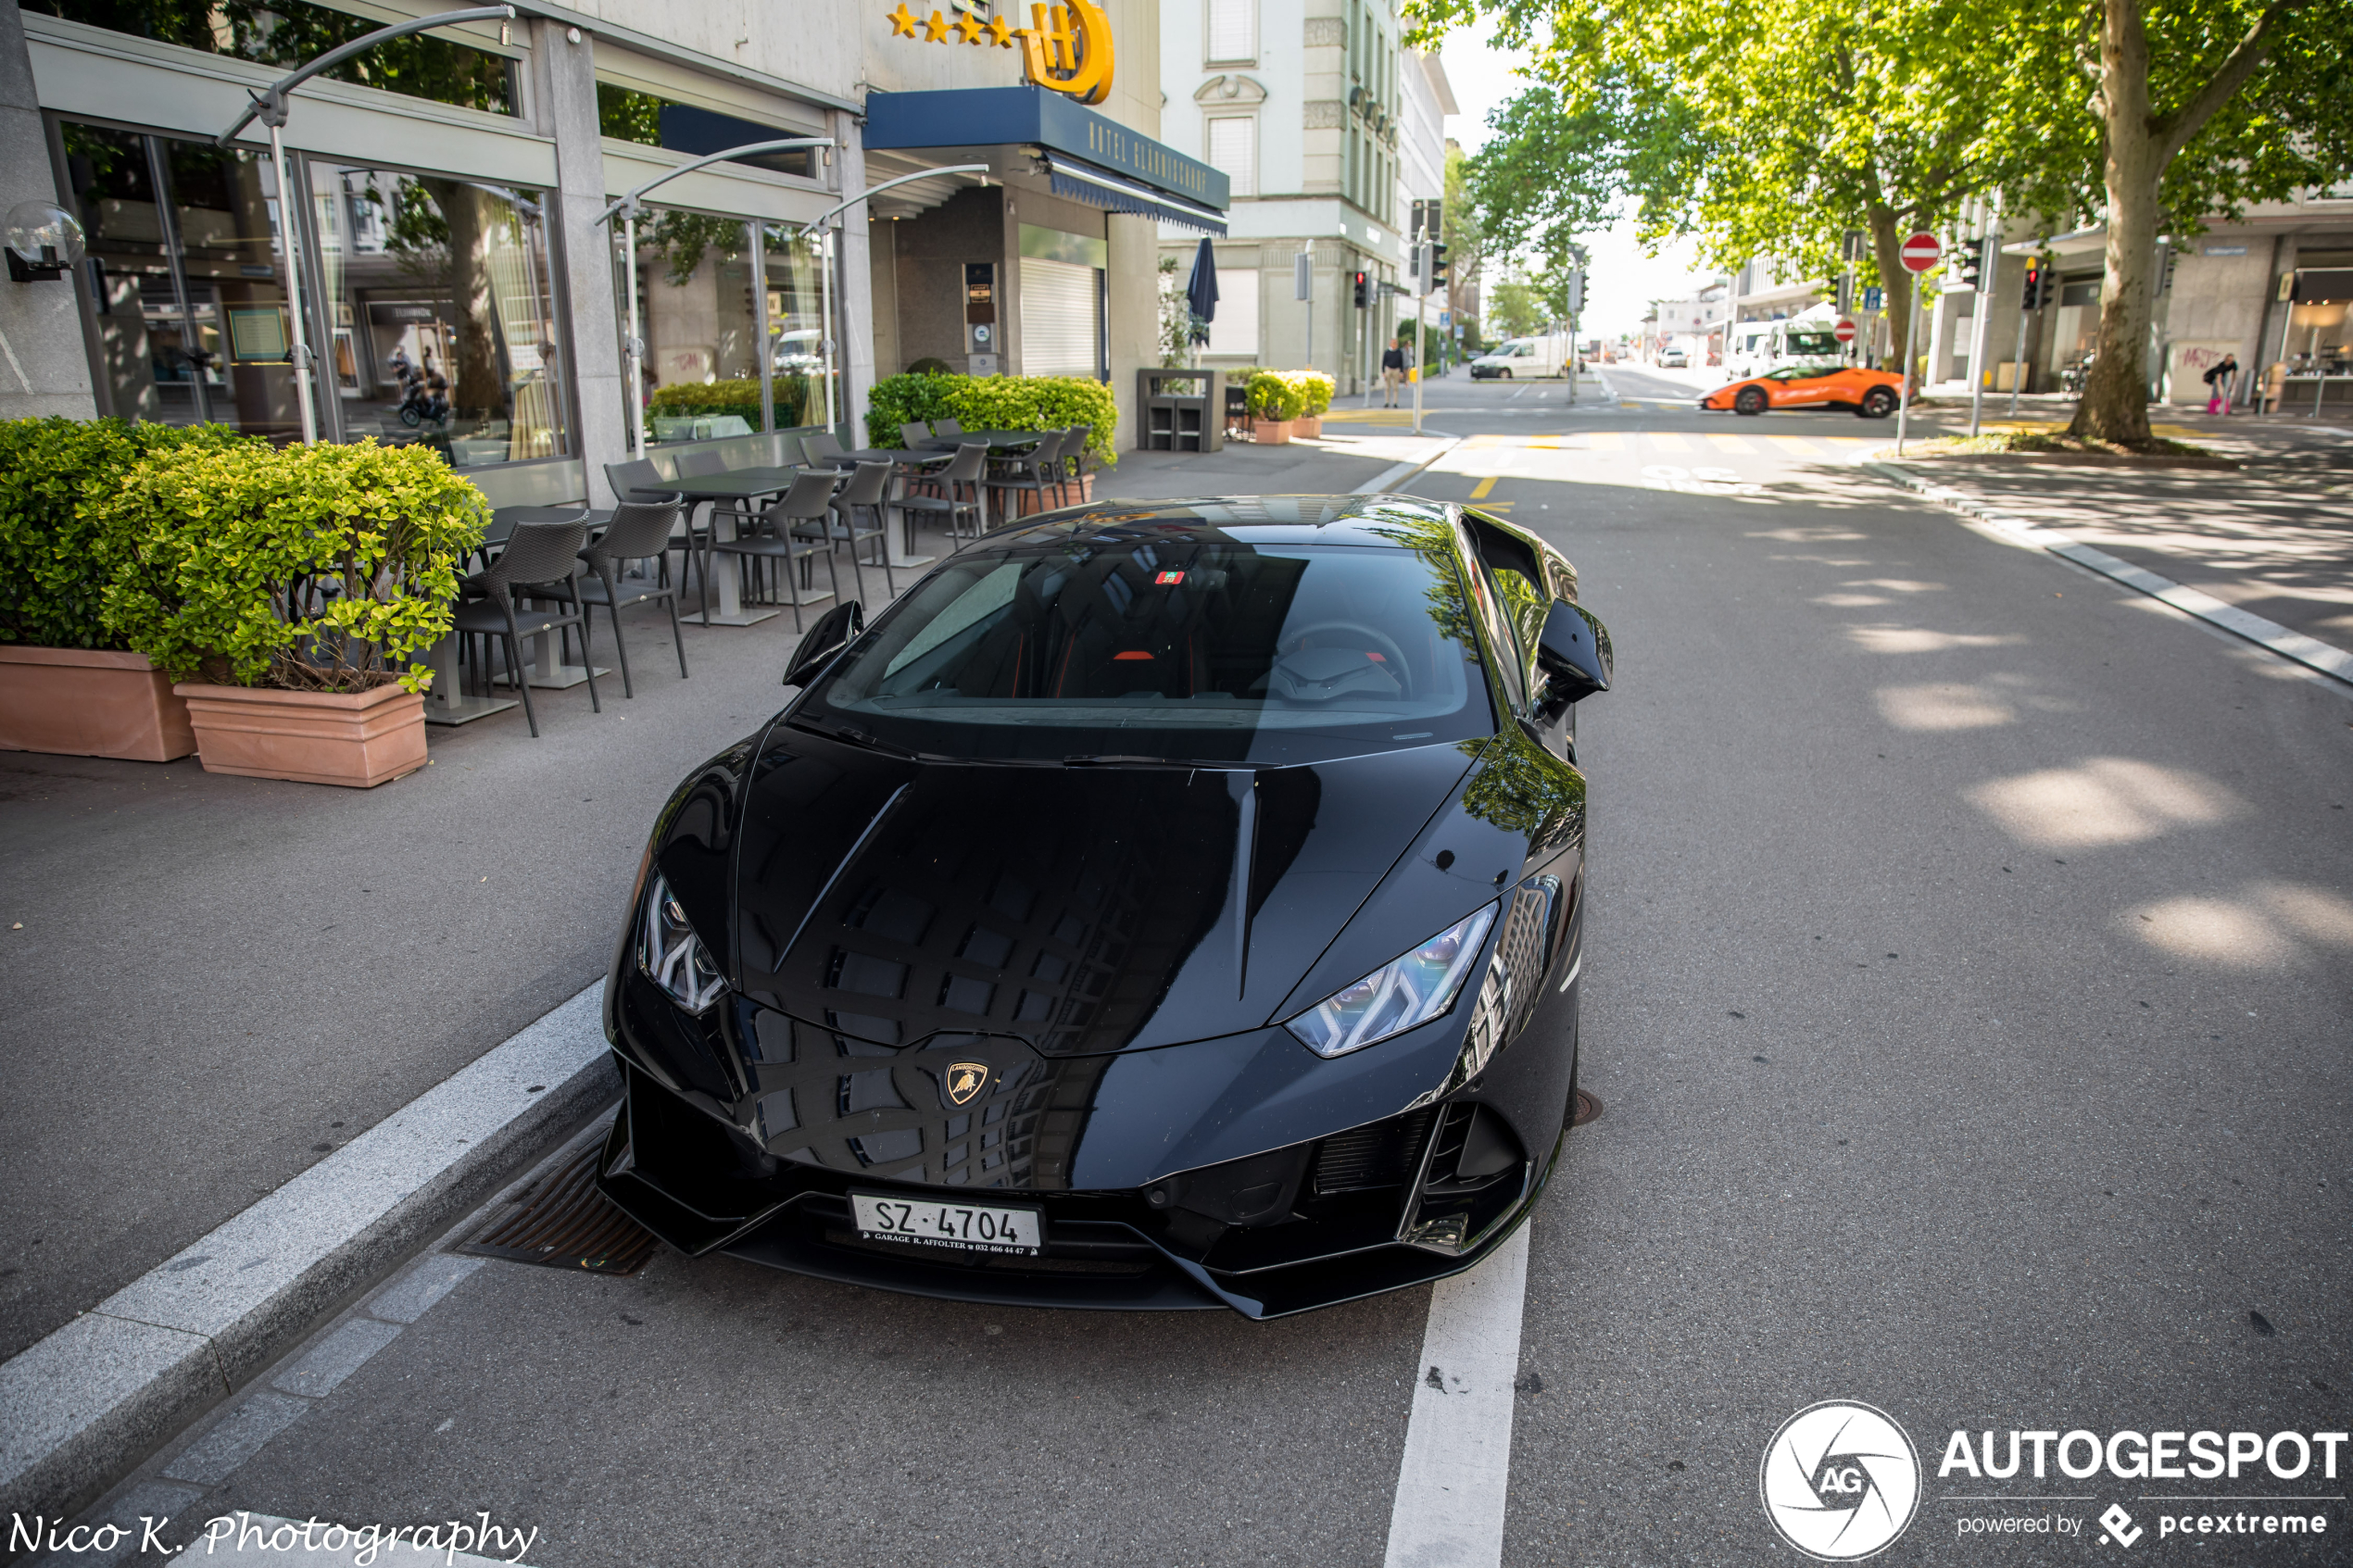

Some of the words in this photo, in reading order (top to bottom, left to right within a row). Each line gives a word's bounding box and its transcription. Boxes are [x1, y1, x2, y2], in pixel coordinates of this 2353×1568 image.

[1089, 121, 1126, 163] HOTEL
[951, 1064, 986, 1073] LAMBORGHINI
[875, 1233, 911, 1243] GARAGE
[923, 1238, 966, 1249] AFFOLTER
[975, 1244, 988, 1252] 032
[989, 1245, 1003, 1253] 466
[1004, 1246, 1014, 1254] 44
[1014, 1247, 1025, 1255] 47
